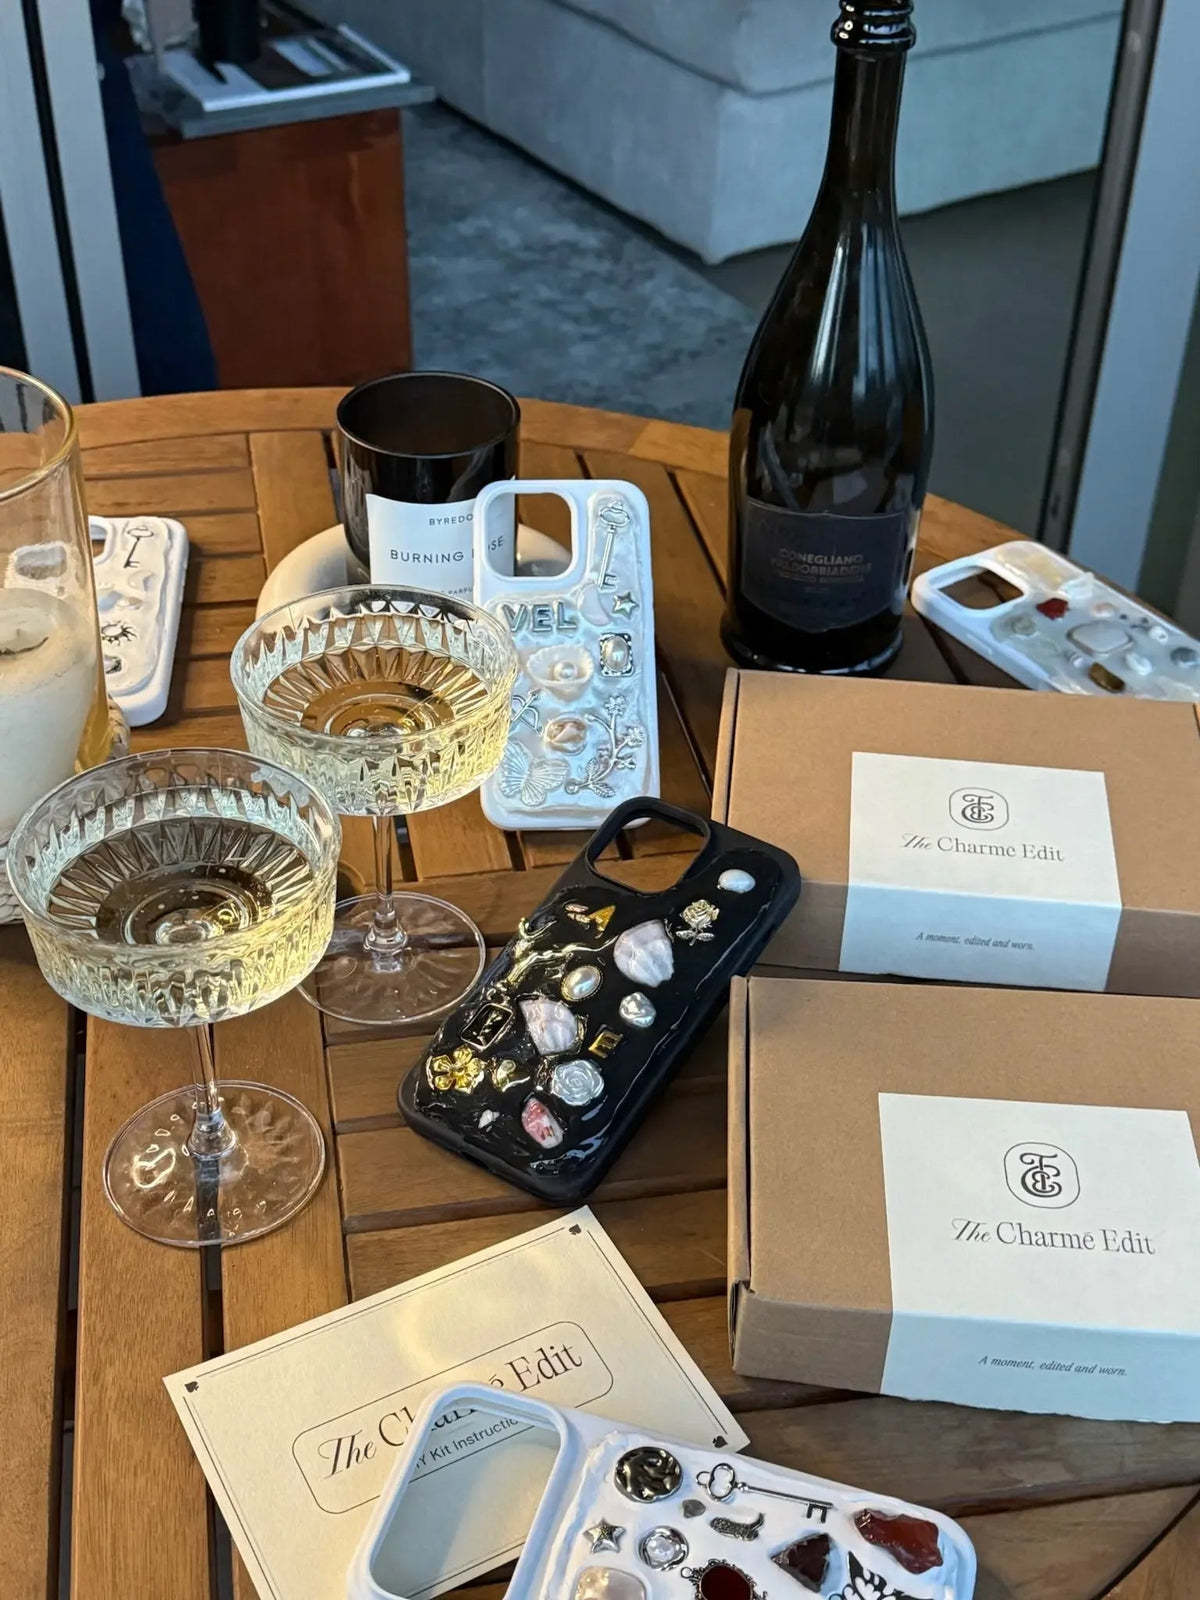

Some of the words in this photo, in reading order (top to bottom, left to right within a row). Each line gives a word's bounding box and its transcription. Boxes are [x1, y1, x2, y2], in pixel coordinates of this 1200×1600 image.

[429, 513, 473, 526] BYREDO
[390, 549, 465, 563] BURNING
[900, 833, 932, 849] The
[1022, 843, 1065, 862] Edit
[915, 931, 924, 941] A
[963, 936, 992, 947] edited
[992, 939, 1011, 949] and
[952, 1218, 991, 1242] The
[1100, 1228, 1156, 1255] Edit
[978, 1355, 988, 1366] A
[990, 1356, 1035, 1371] moment,
[1039, 1360, 1075, 1373] edited
[1074, 1362, 1098, 1375] and
[1099, 1366, 1128, 1377] worn.
[317, 1428, 377, 1480] The
[506, 1344, 583, 1393] Edit
[429, 1444, 452, 1461] Kit
